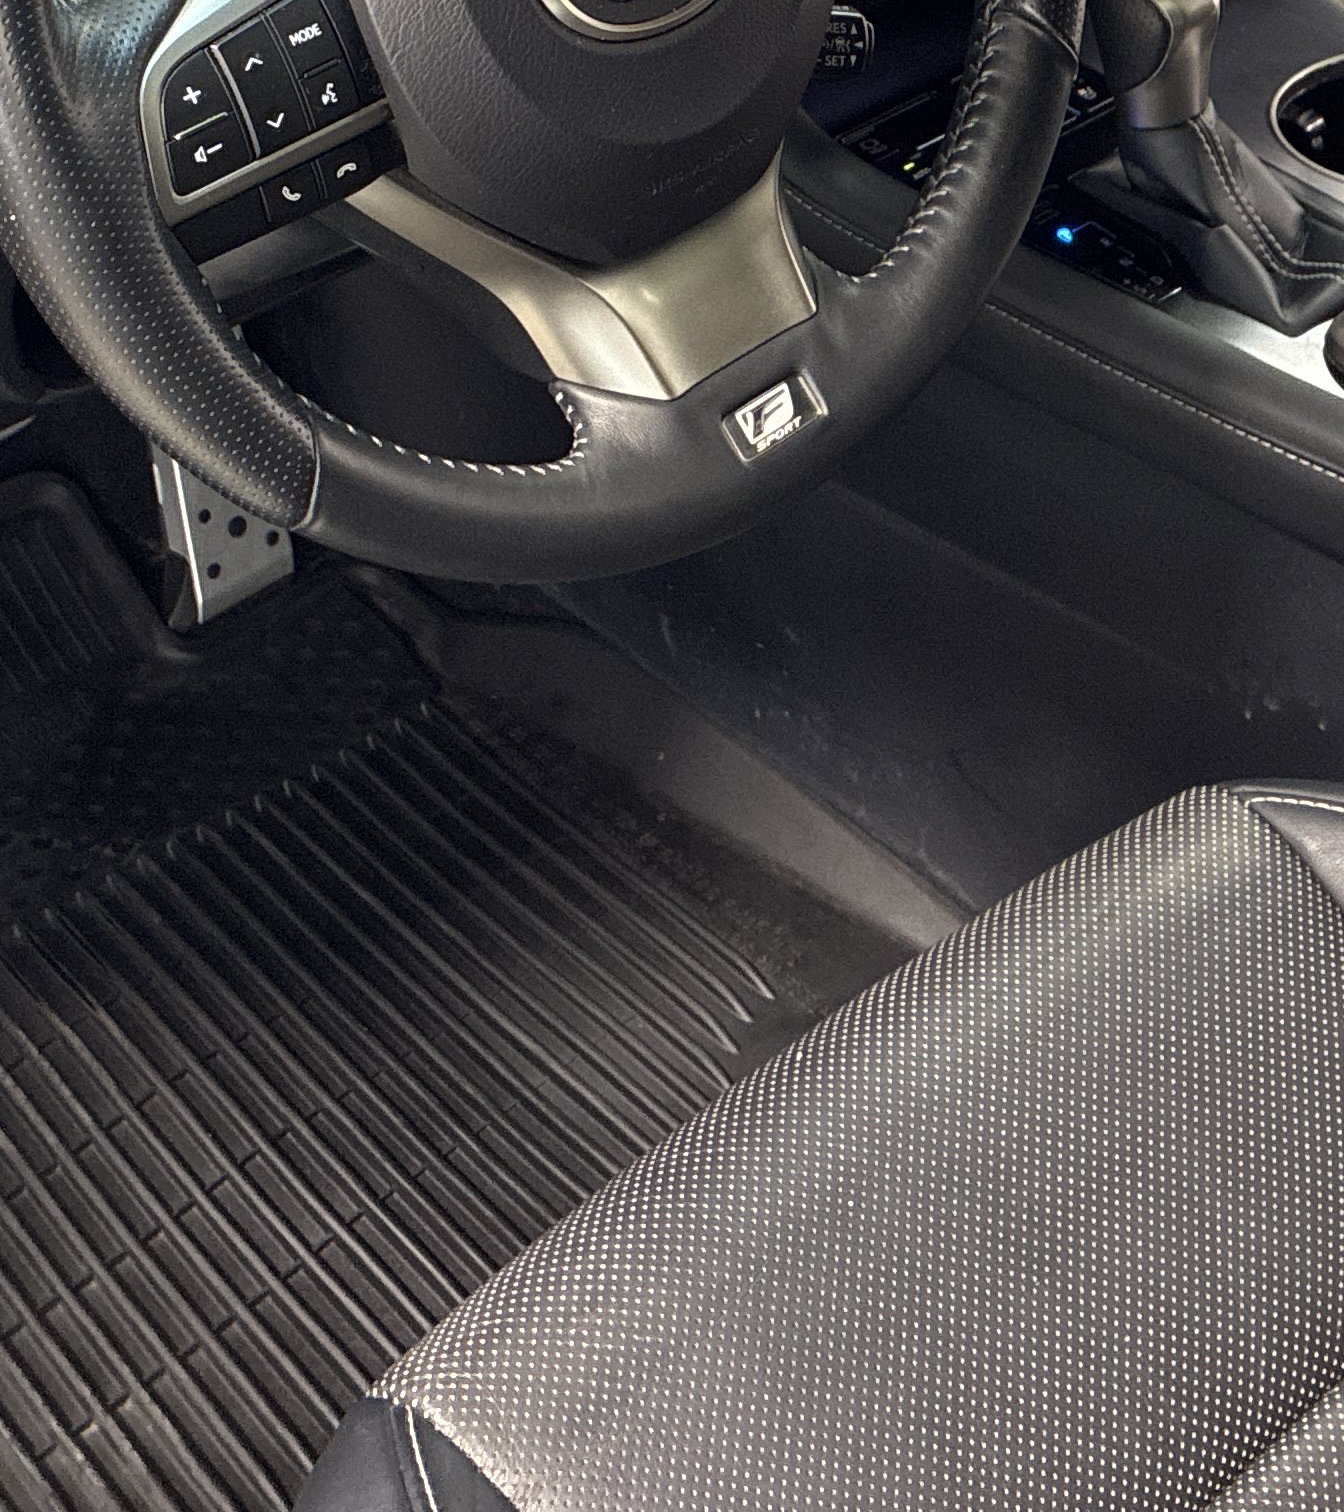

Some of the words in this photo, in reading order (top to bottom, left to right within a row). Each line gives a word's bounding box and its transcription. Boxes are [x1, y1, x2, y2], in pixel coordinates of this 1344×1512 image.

[288, 22, 323, 47] MODE
[824, 54, 847, 67] SET
[756, 415, 802, 453] SPORT
